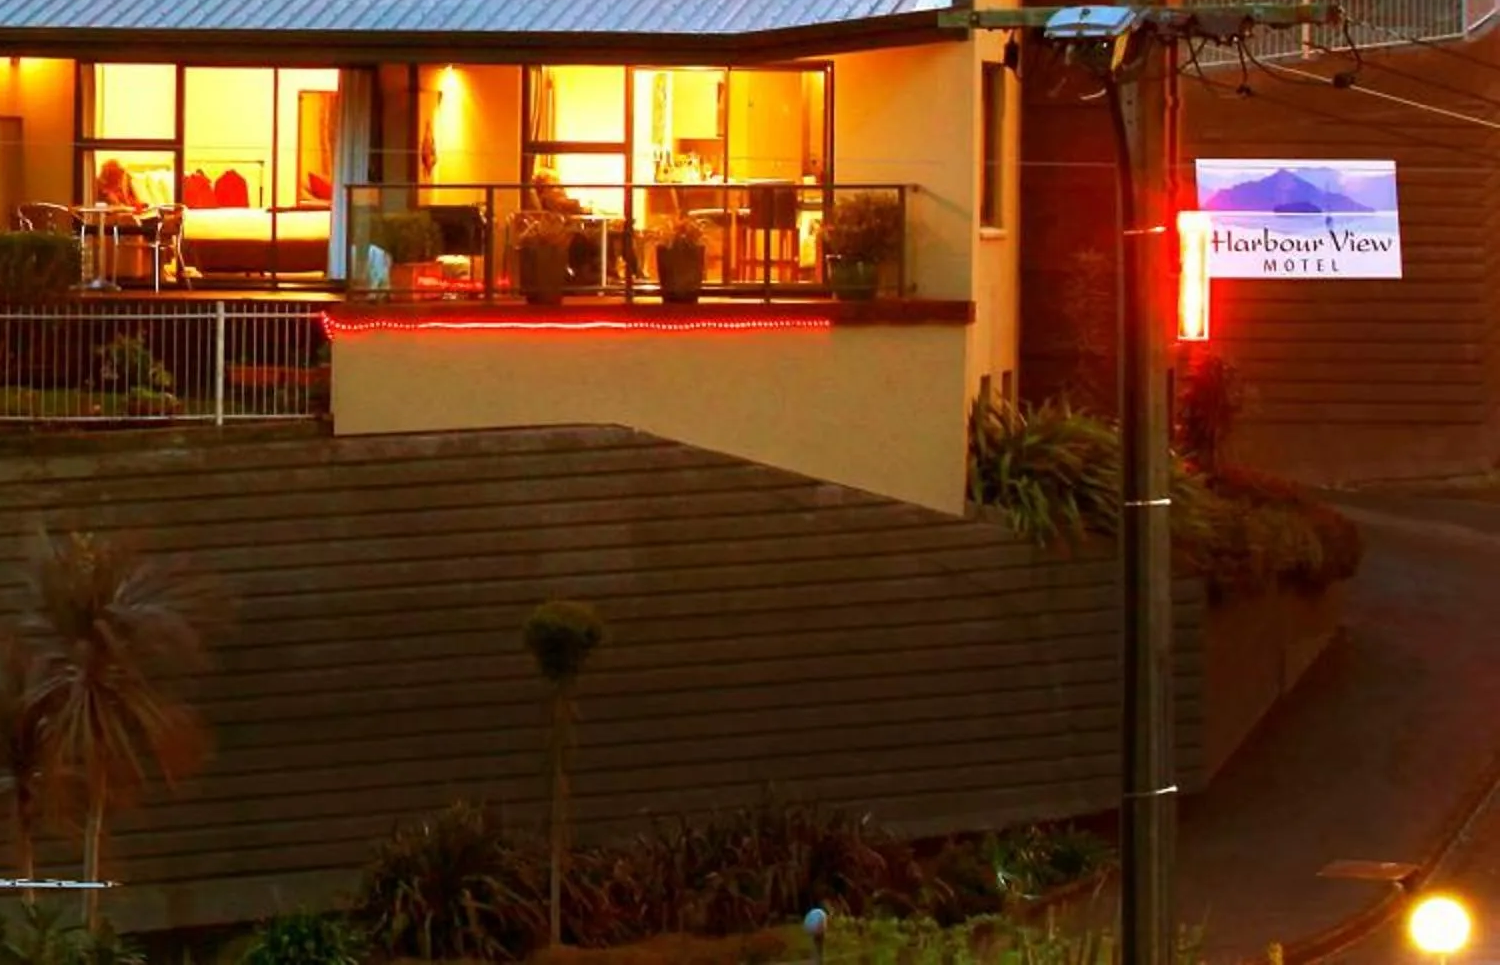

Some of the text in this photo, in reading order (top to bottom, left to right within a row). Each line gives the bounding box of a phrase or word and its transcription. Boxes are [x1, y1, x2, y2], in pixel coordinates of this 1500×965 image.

[1211, 227, 1393, 253] Harbour View
[1263, 258, 1340, 272] MOTEL
